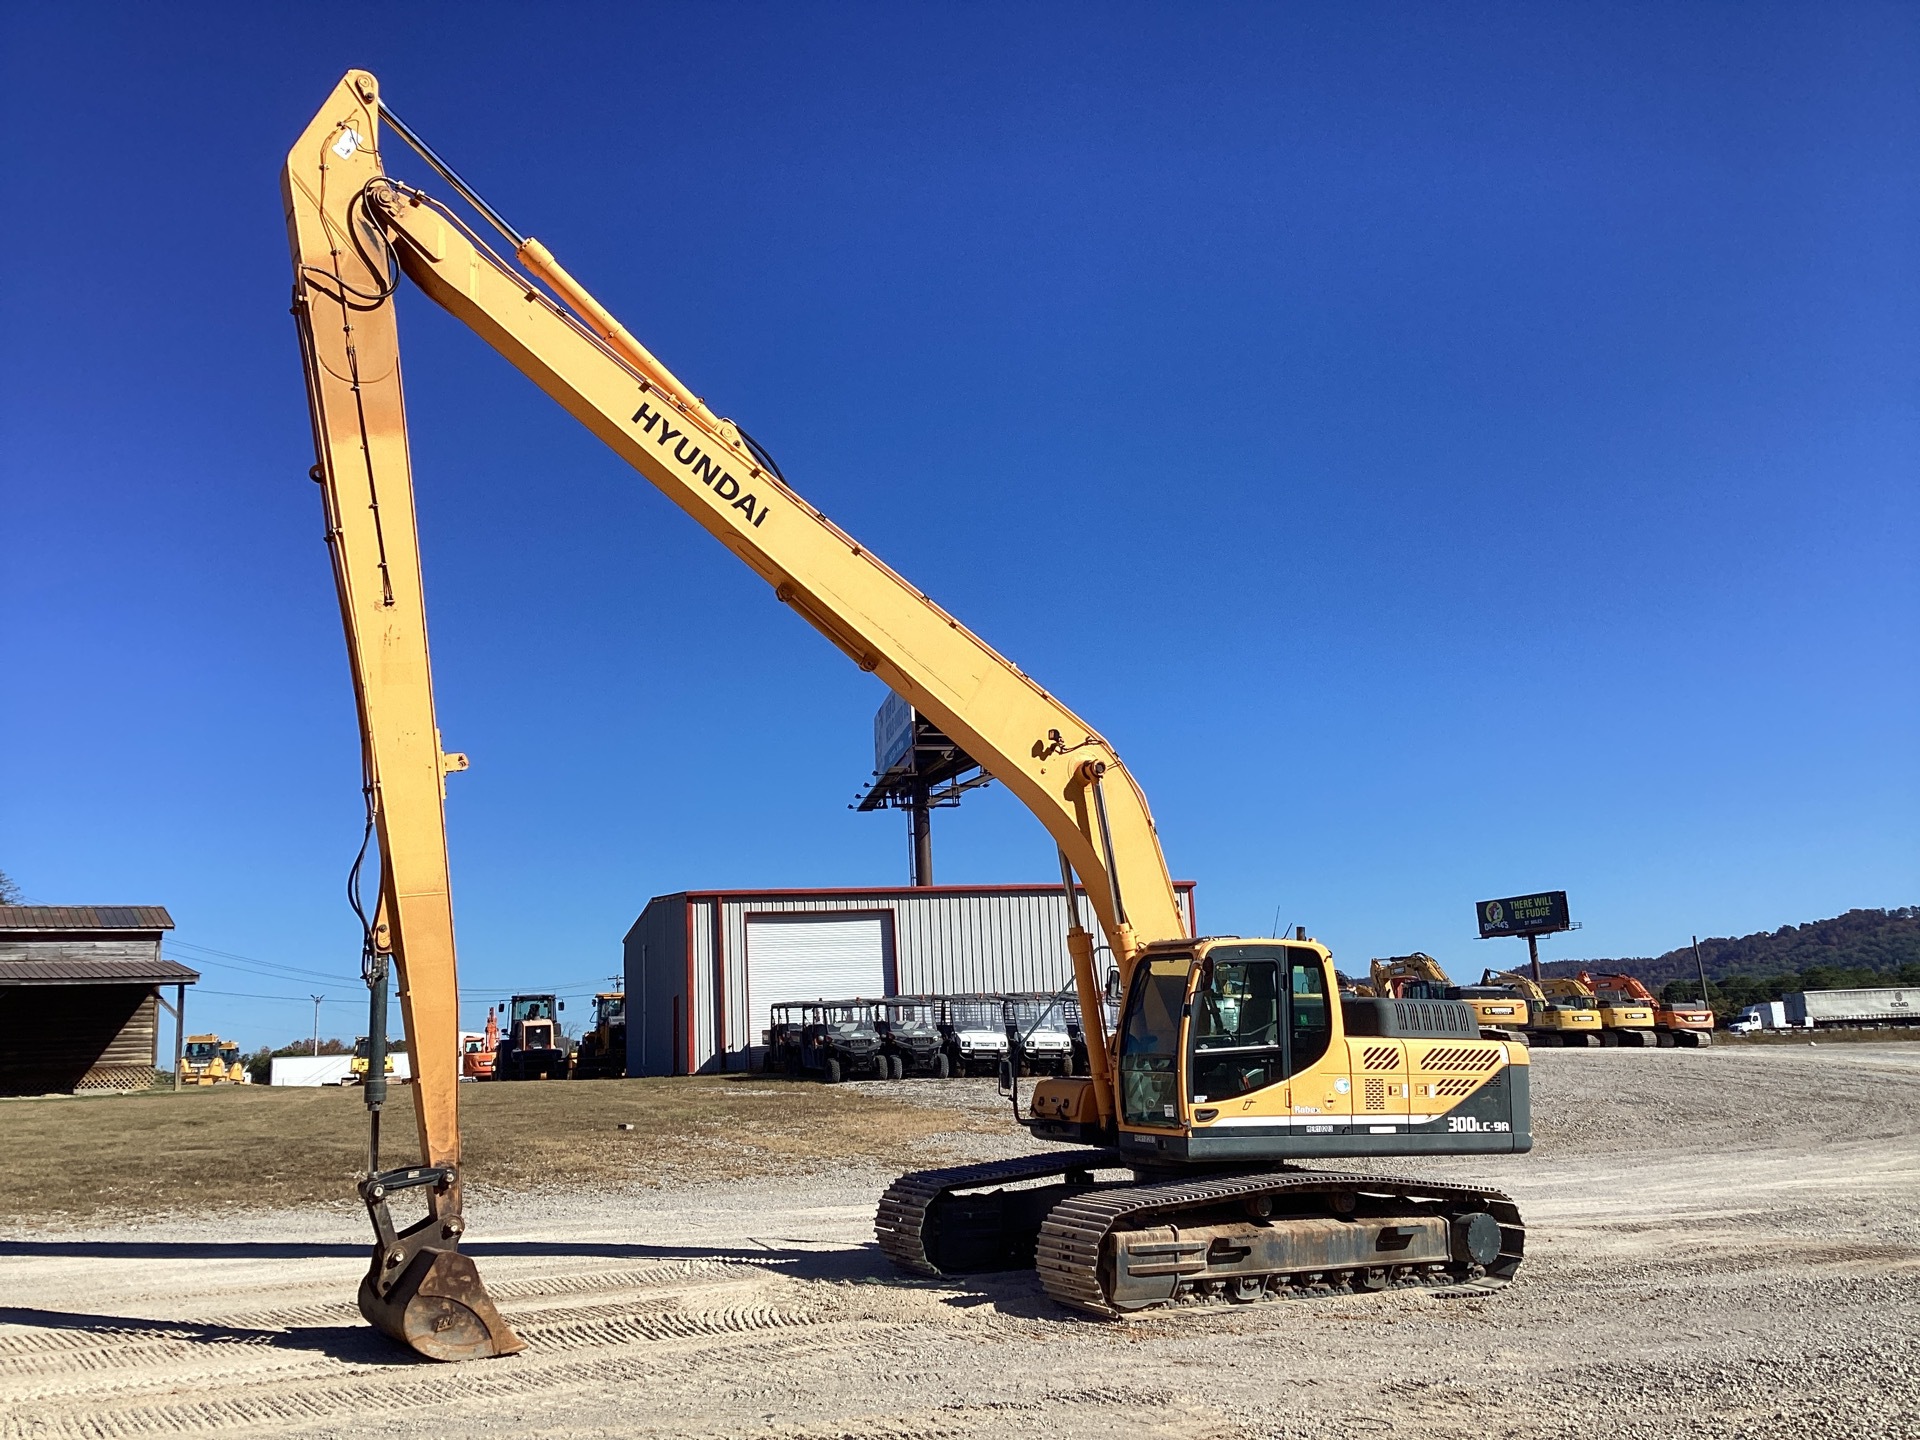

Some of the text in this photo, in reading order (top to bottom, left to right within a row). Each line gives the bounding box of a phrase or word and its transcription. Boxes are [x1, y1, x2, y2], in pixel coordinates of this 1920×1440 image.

[631, 402, 770, 528] HYUNDAI
[1509, 896, 1553, 909] THERE WILL
[1515, 907, 1550, 920] BE FUDGE
[1294, 1105, 1322, 1114] Robex
